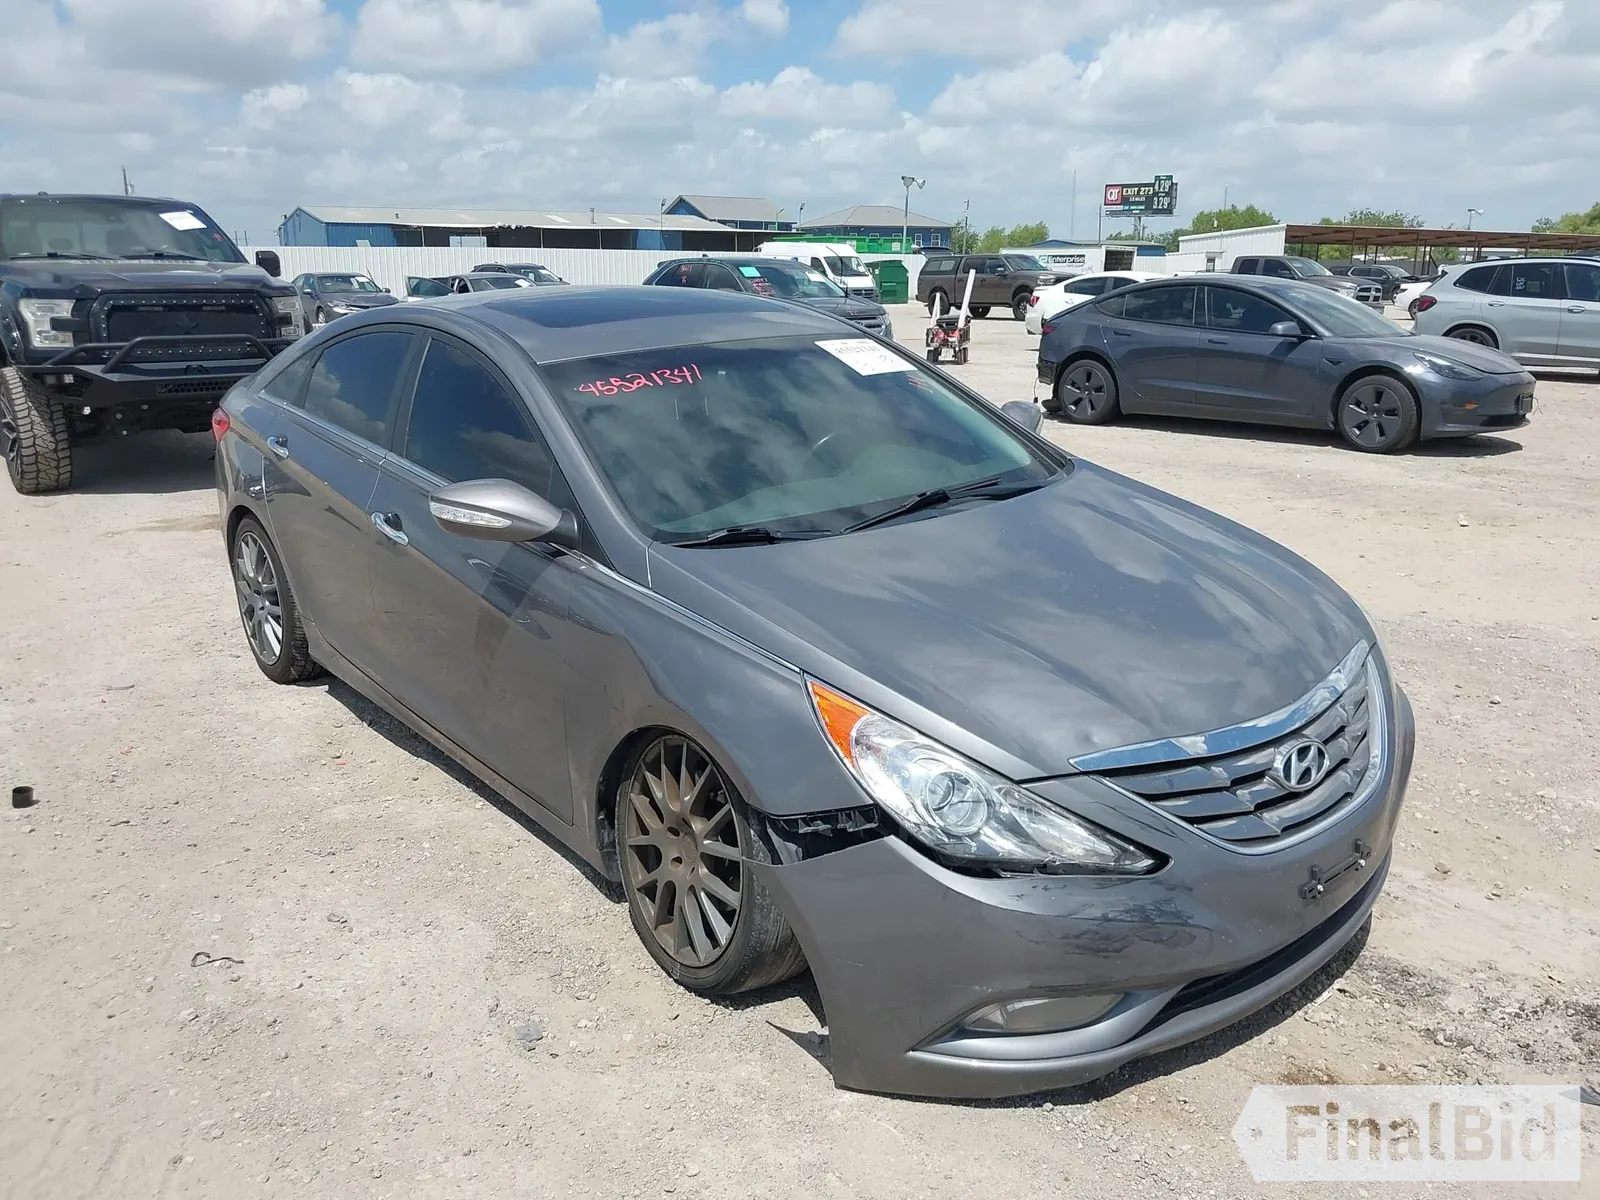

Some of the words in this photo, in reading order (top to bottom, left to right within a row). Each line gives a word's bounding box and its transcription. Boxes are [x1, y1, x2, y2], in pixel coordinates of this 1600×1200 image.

[1107, 189, 1120, 201] QT
[1122, 188, 1138, 196] EXIT
[1139, 187, 1153, 195] 273
[1048, 255, 1085, 264] Enterprise
[578, 364, 702, 397] 45521341
